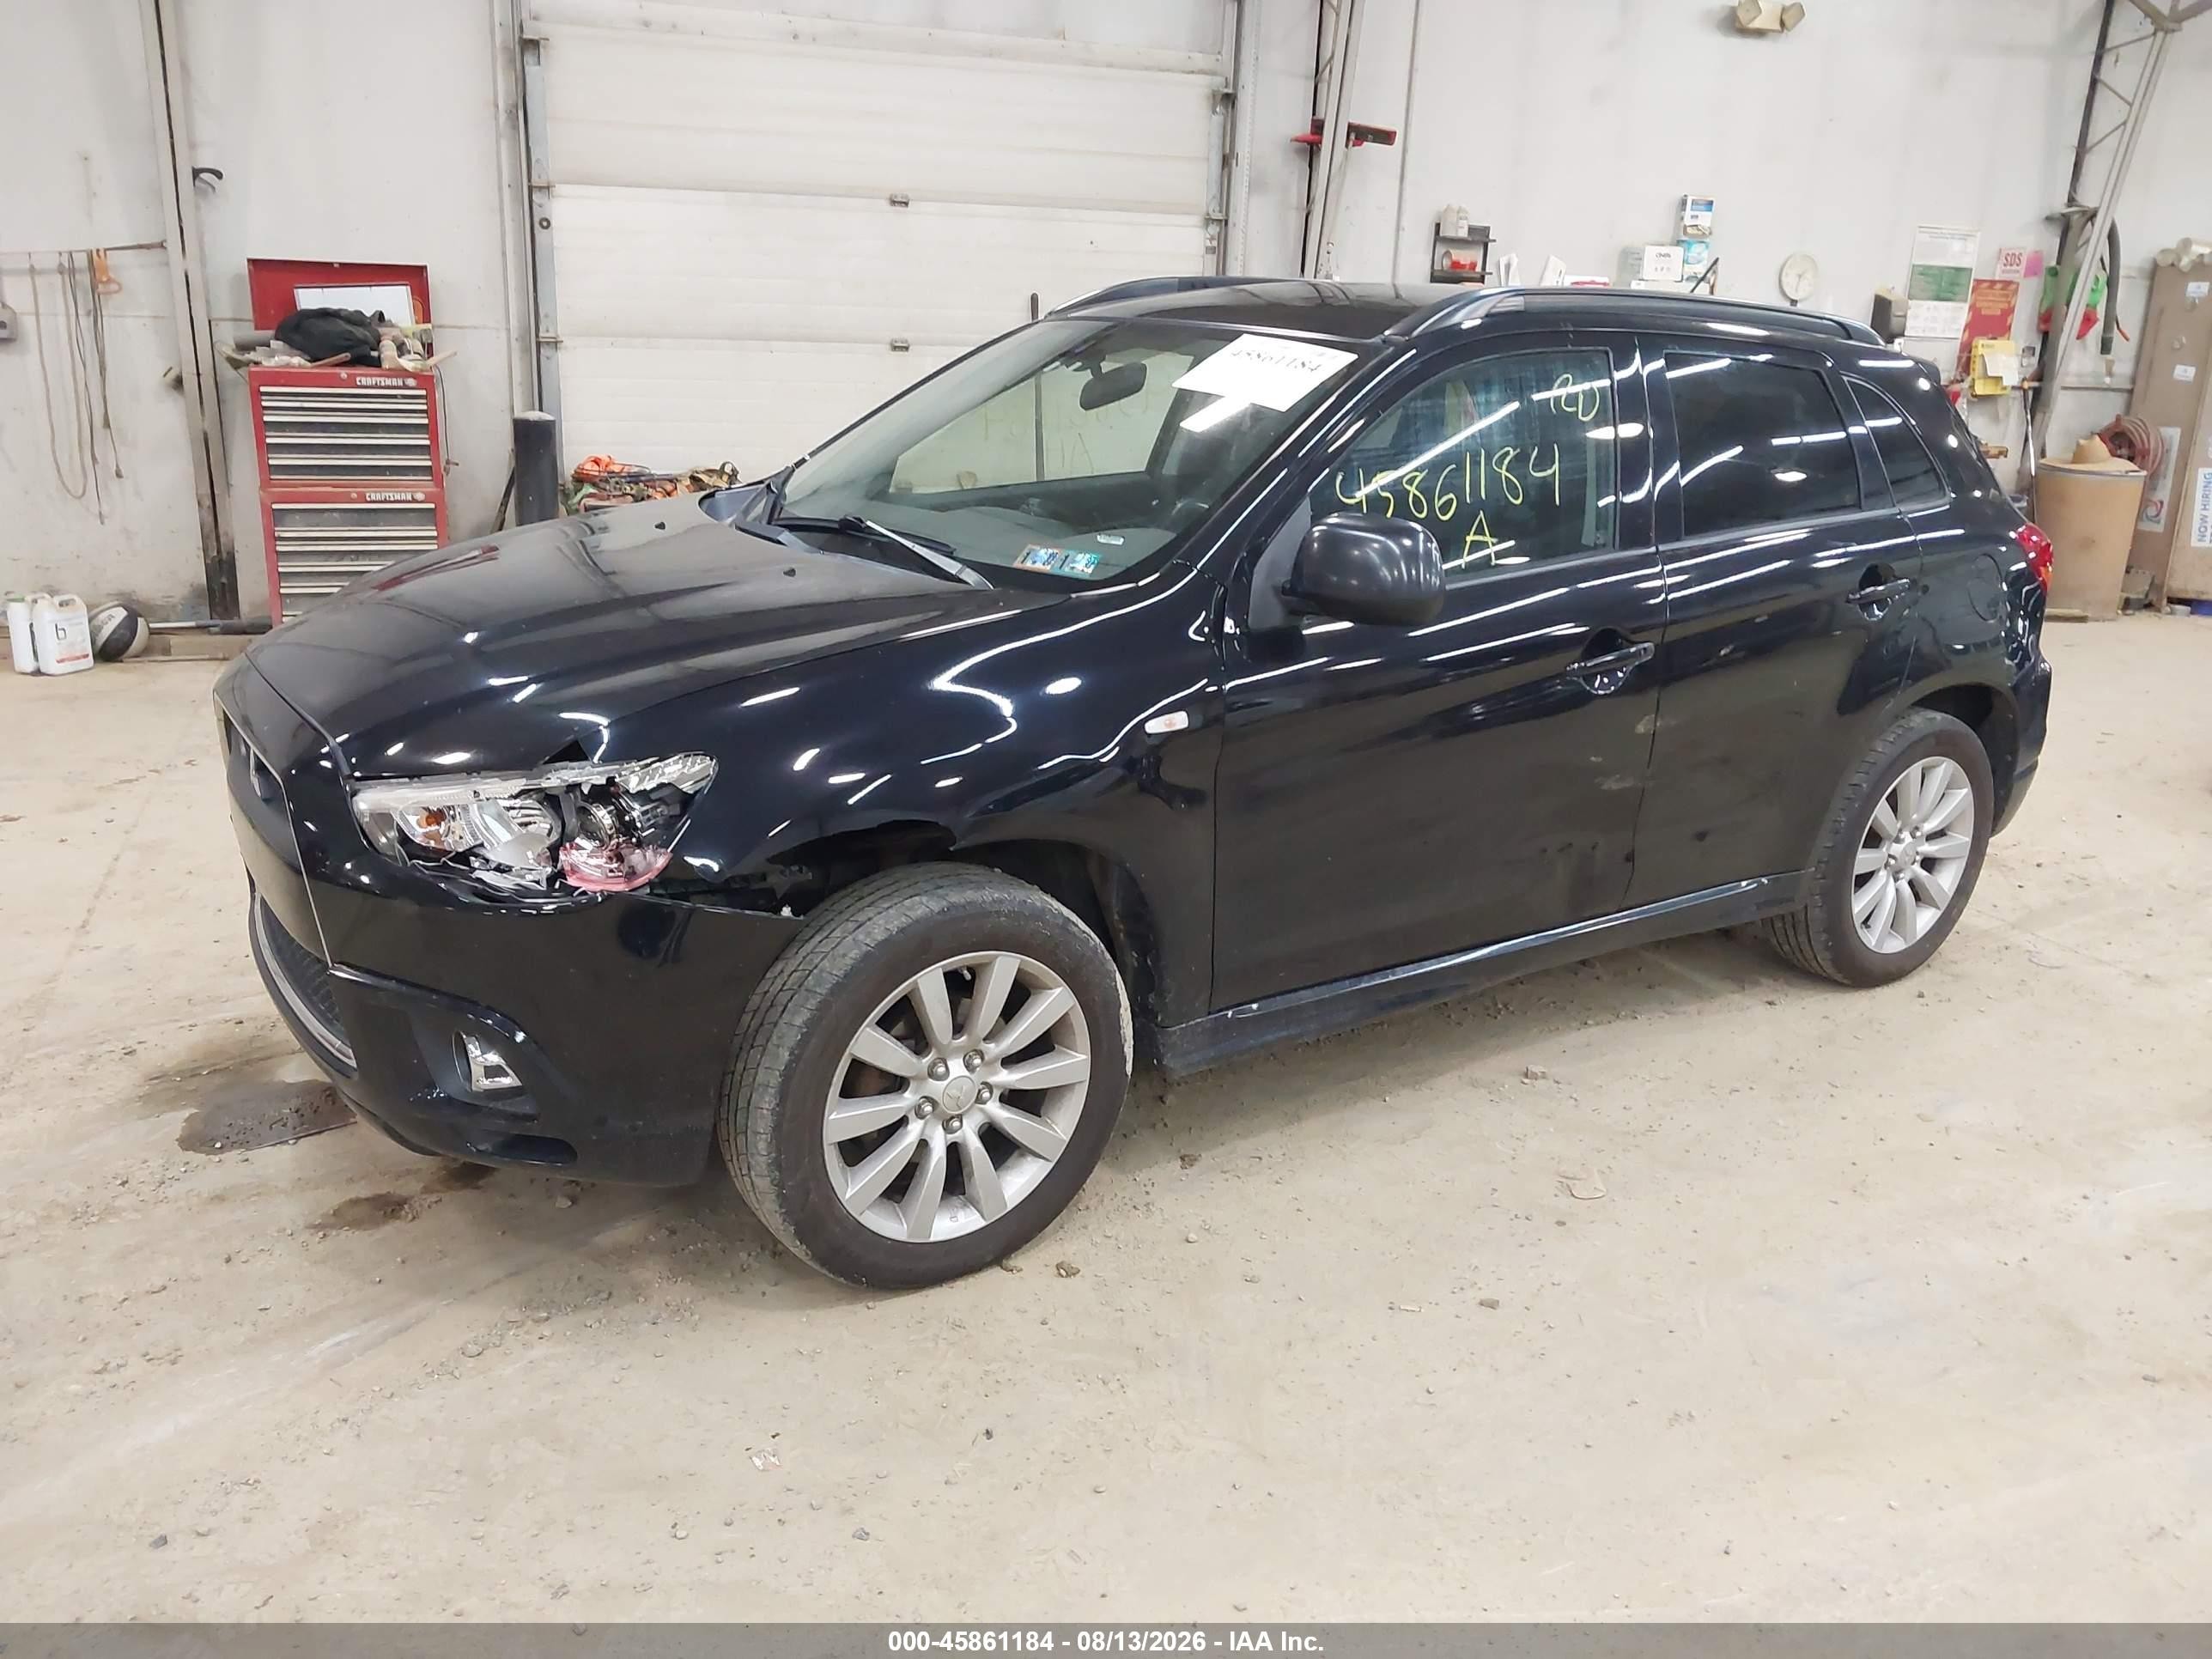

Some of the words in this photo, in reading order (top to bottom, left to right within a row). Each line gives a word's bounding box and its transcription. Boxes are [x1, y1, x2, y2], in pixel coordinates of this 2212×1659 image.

[2002, 252, 2023, 267] SDS
[356, 376, 404, 387] CRAFTSMAN
[1335, 442, 1561, 521] 45861184
[365, 492, 413, 501] CRAFTSMAN
[1462, 510, 1498, 569] A
[2197, 514, 2209, 543] NOW
